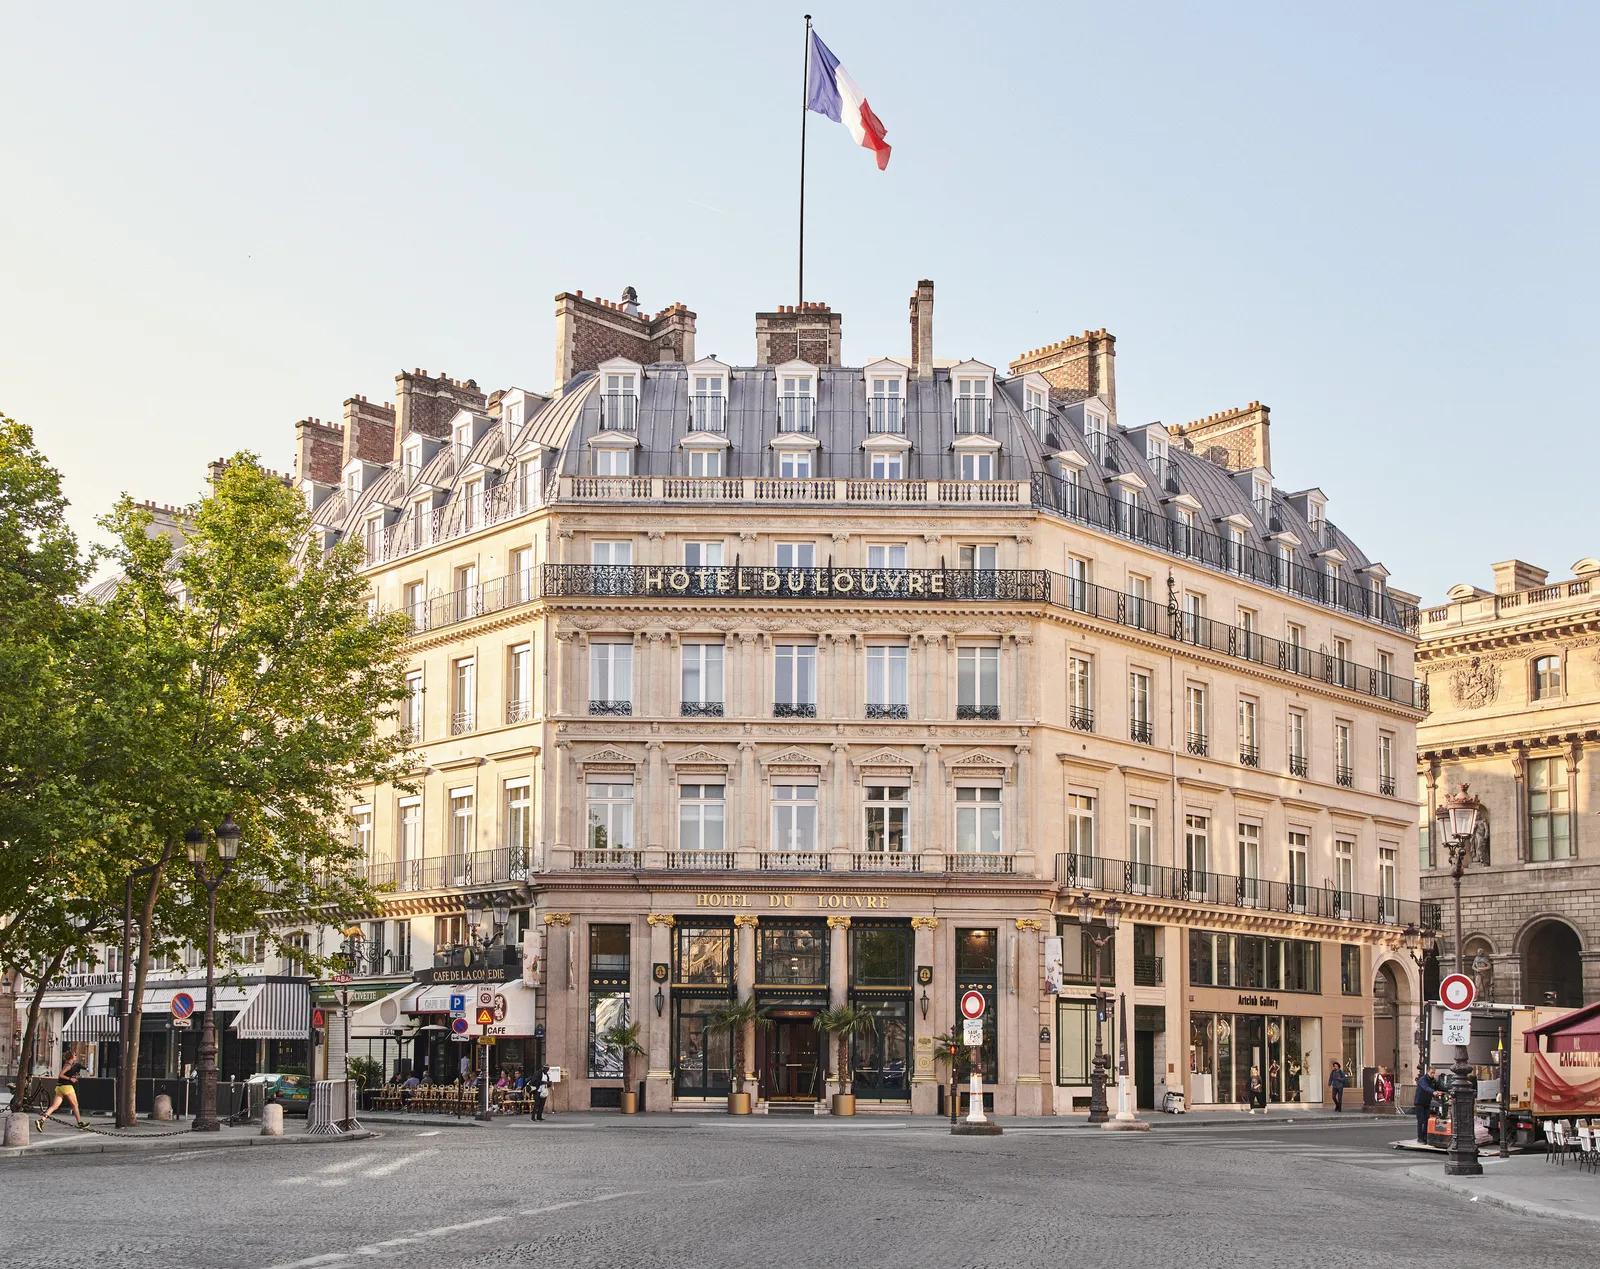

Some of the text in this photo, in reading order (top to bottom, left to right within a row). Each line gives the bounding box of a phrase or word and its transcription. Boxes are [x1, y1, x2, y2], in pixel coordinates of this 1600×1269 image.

[645, 567, 945, 593] HOTEL DU LOUVRE
[695, 893, 889, 909] HOTEL DU LOUVRE
[450, 970, 460, 981] DE
[461, 970, 472, 980] LA
[453, 997, 461, 1009] P
[1259, 995, 1279, 1010] Gallery
[487, 1026, 506, 1035] CAFE
